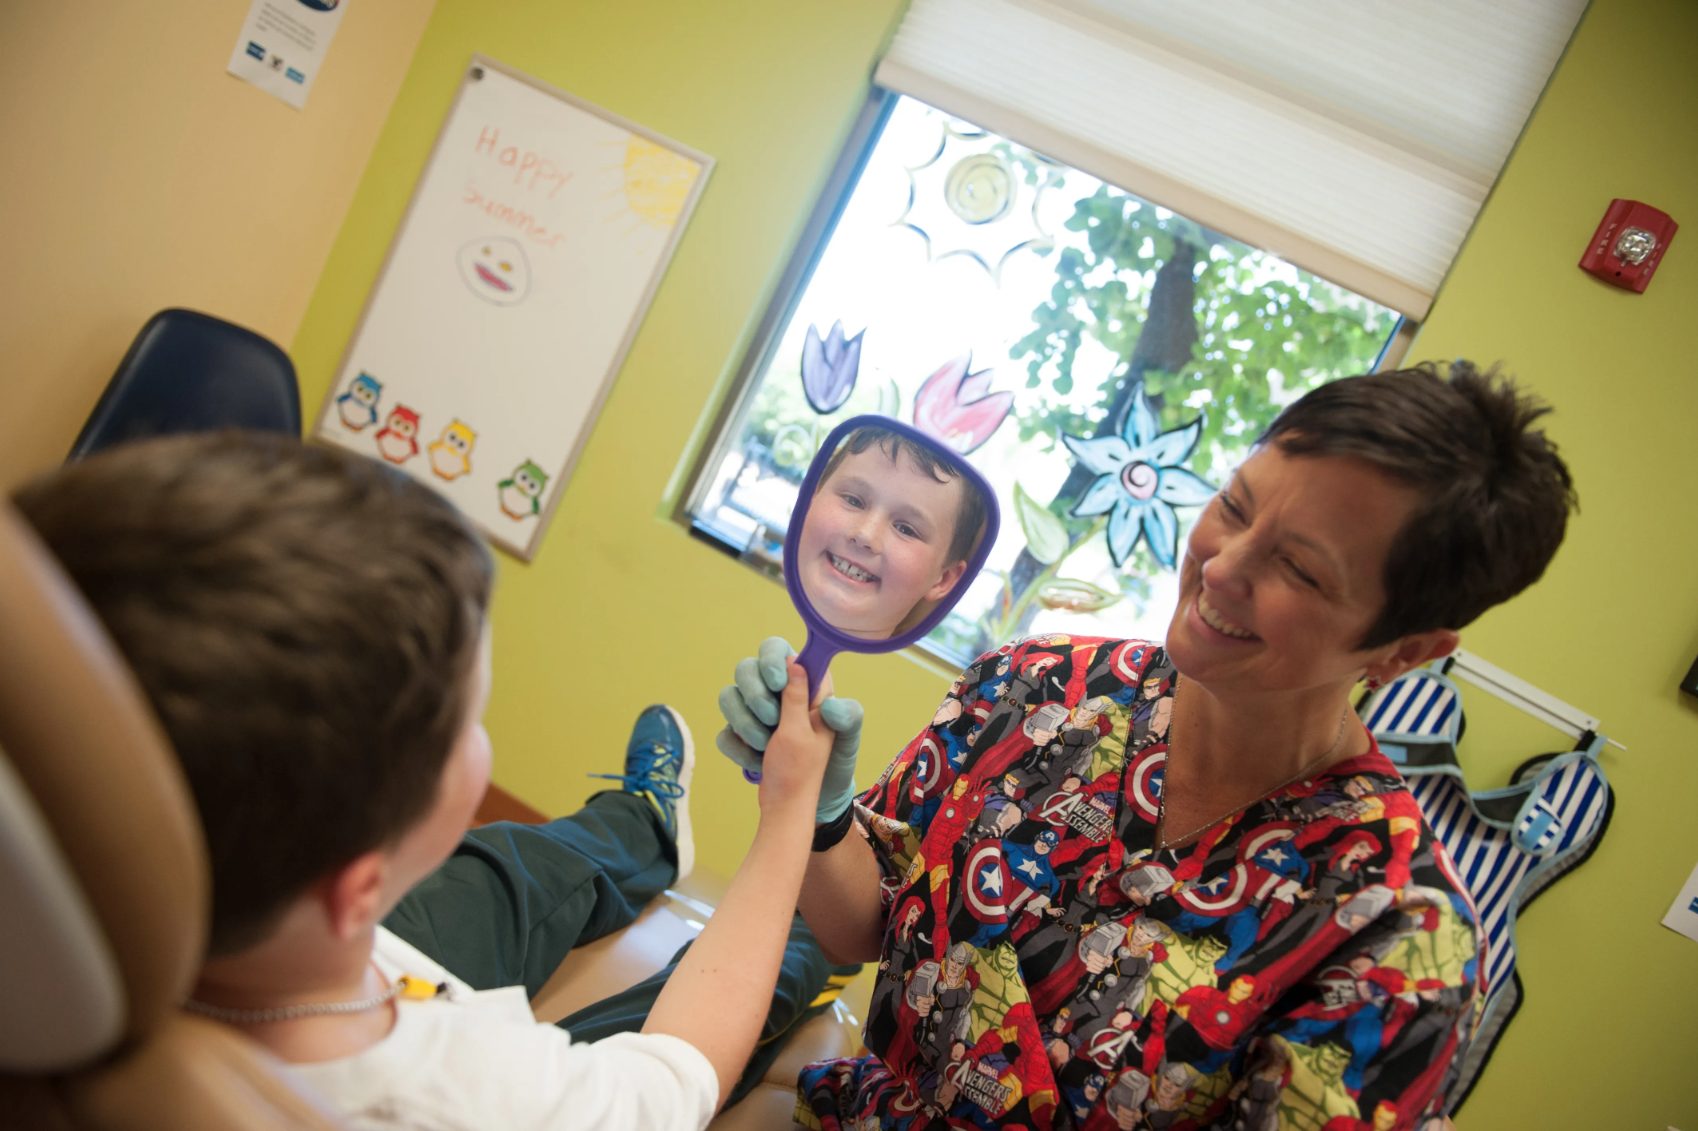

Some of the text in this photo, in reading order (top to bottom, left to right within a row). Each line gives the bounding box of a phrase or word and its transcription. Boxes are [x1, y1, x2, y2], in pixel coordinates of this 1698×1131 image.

[475, 127, 574, 199] Happy
[1596, 223, 1616, 255] FIRE
[1089, 796, 1111, 815] MARVEL
[977, 1062, 999, 1080] MARVEL
